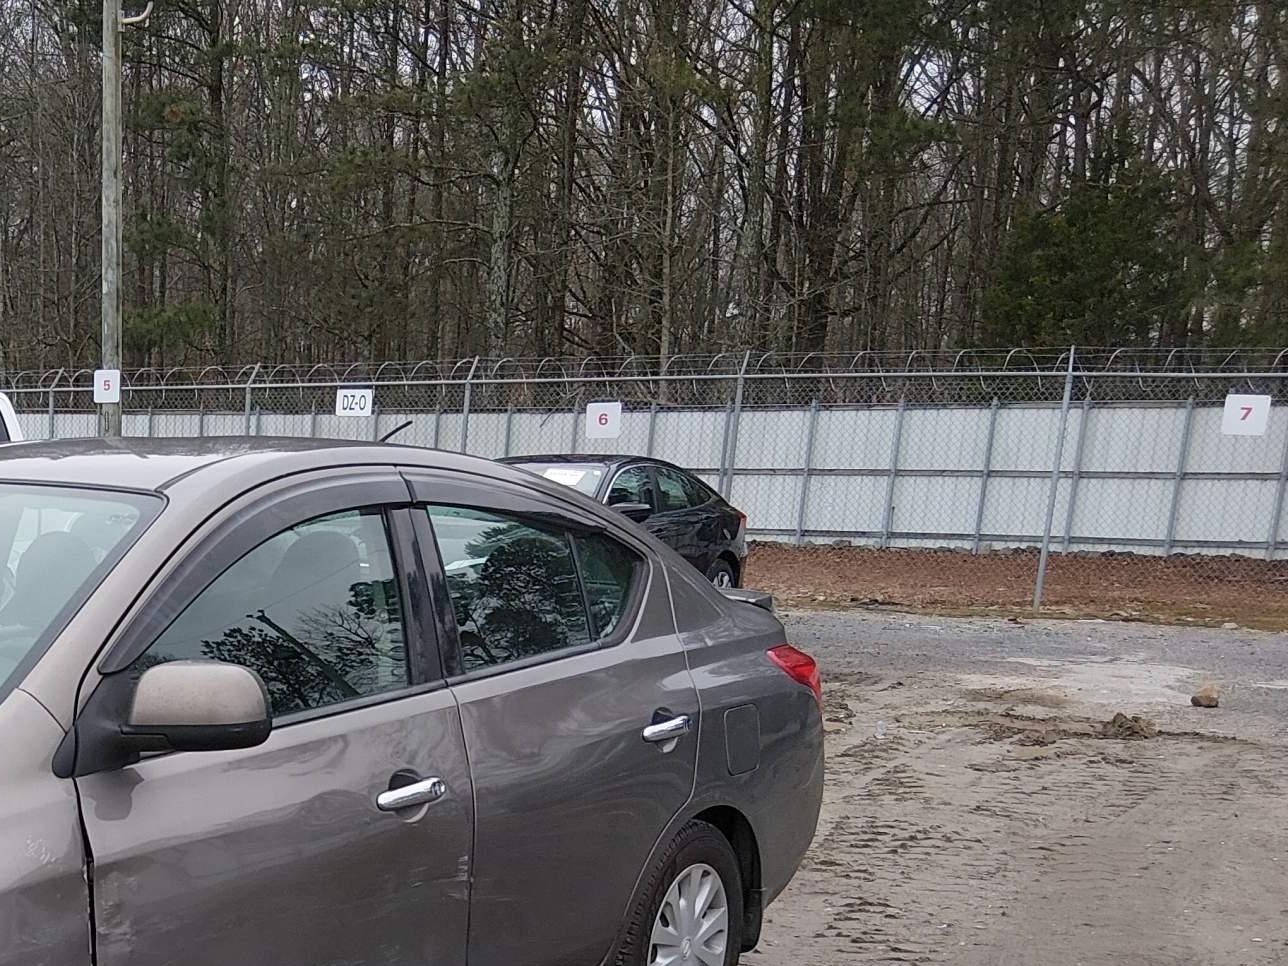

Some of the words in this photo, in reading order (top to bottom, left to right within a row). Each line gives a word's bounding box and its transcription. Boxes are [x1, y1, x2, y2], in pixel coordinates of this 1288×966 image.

[103, 379, 111, 391] 5
[598, 413, 608, 426] 6
[1240, 407, 1253, 421] 7
